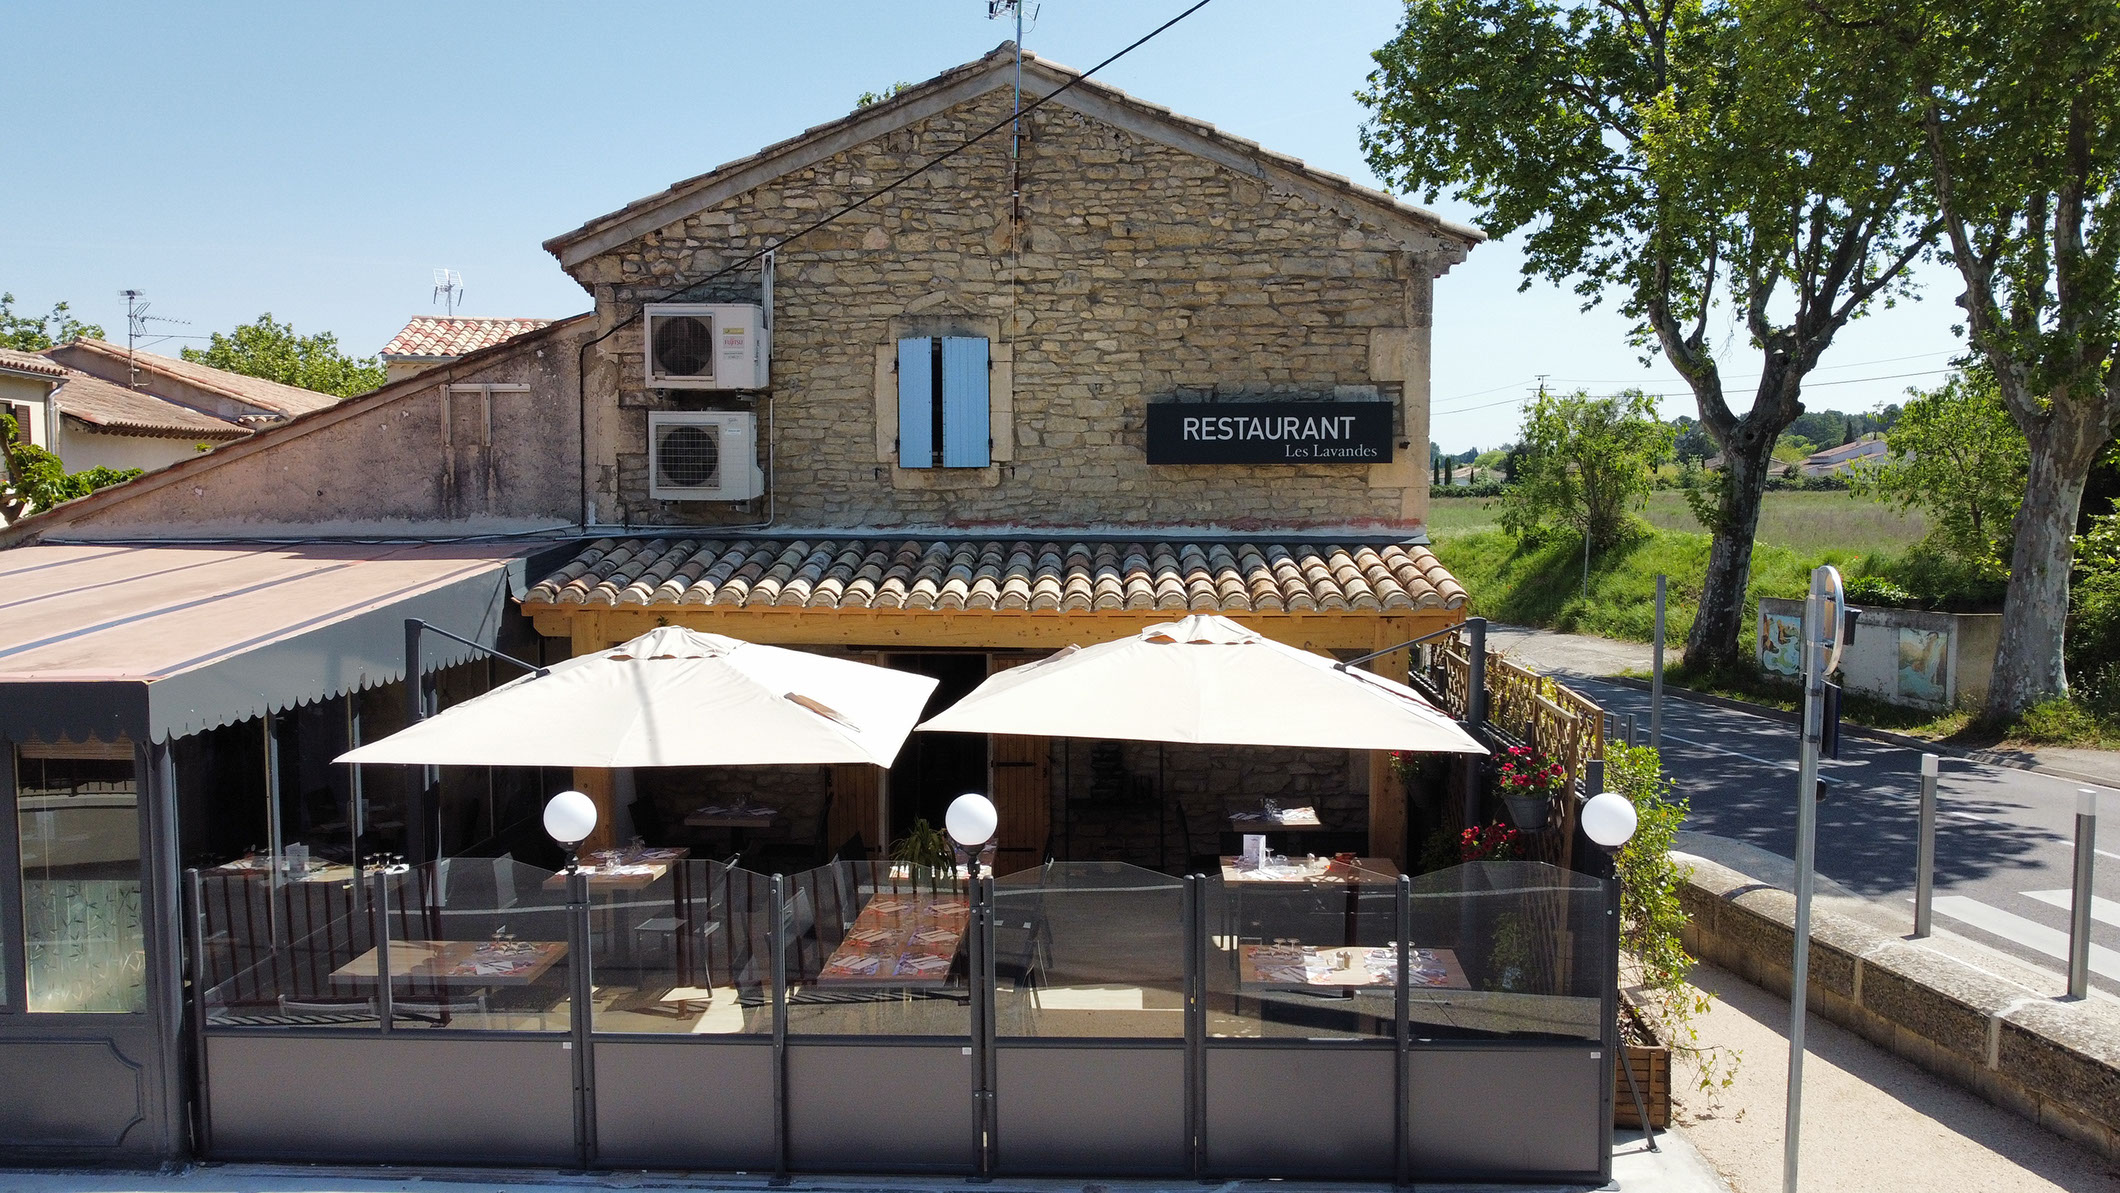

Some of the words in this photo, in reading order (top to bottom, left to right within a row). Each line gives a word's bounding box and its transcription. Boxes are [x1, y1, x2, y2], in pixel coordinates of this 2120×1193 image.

[1183, 416, 1356, 441] RESTAURANT
[1285, 444, 1309, 458] Les
[1313, 443, 1378, 458] Lavandes
